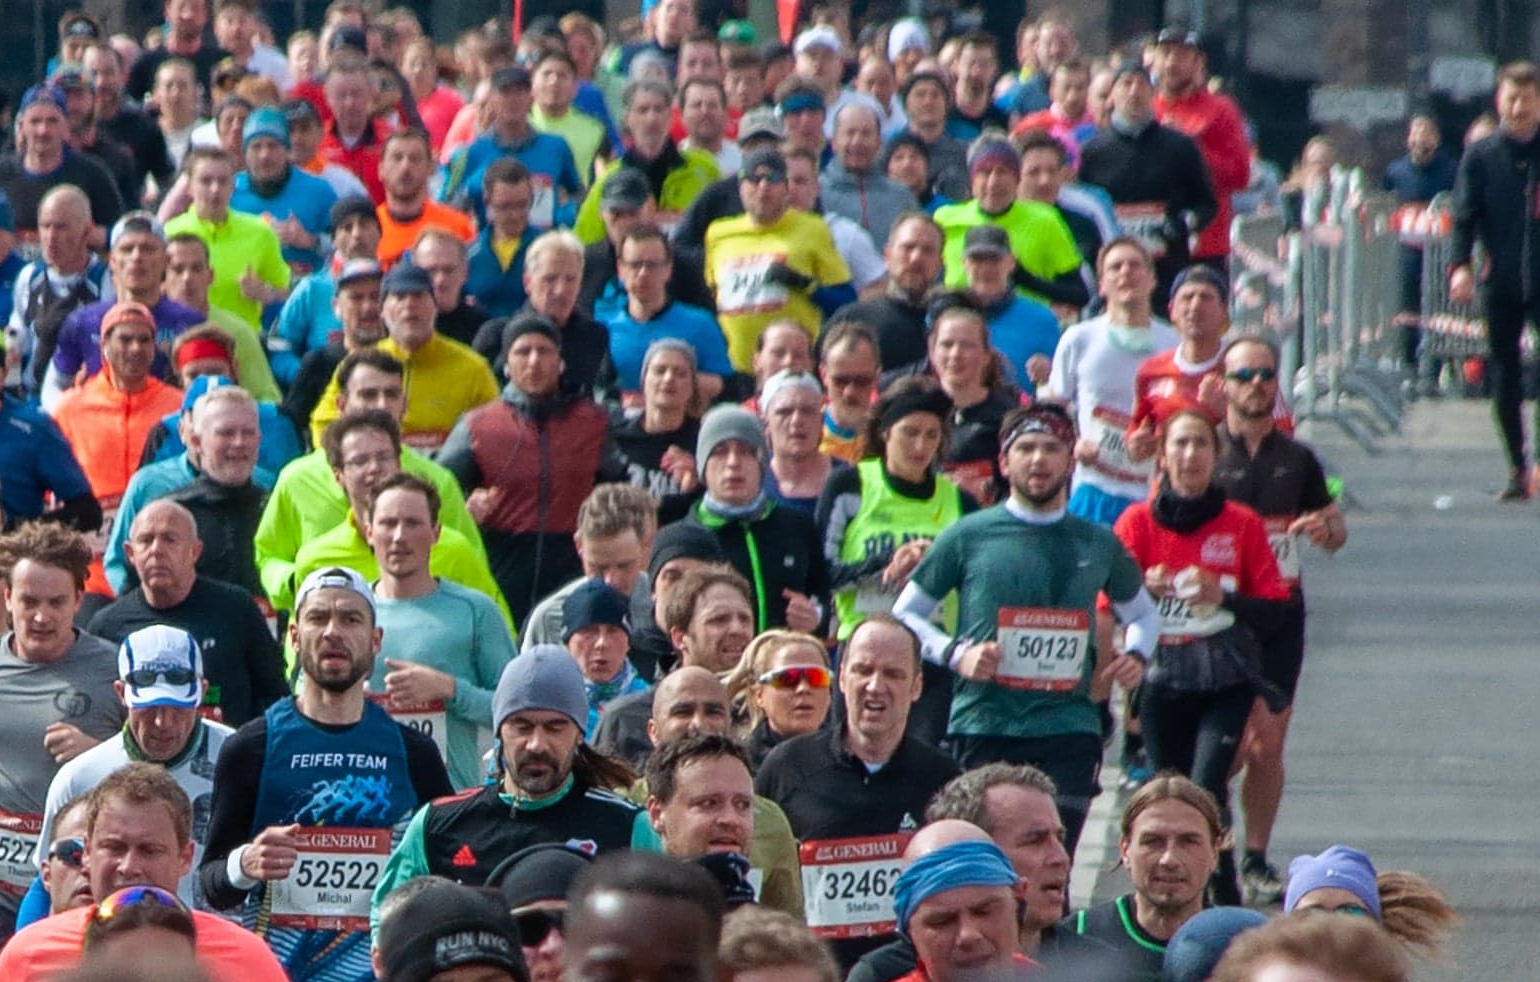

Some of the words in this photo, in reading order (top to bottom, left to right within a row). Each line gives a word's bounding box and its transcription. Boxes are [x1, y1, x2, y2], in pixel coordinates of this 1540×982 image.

[1017, 635, 1080, 660] 50123
[290, 753, 345, 769] FEIFER
[346, 753, 387, 770] TEAM
[310, 832, 377, 850] GENERALI
[833, 839, 898, 859] GENERALI
[295, 859, 380, 891] 52522
[823, 867, 901, 900] 32462
[317, 891, 352, 904] Michal
[845, 901, 880, 914] Stefan
[436, 932, 474, 952] RUN
[478, 931, 509, 953] NYC
